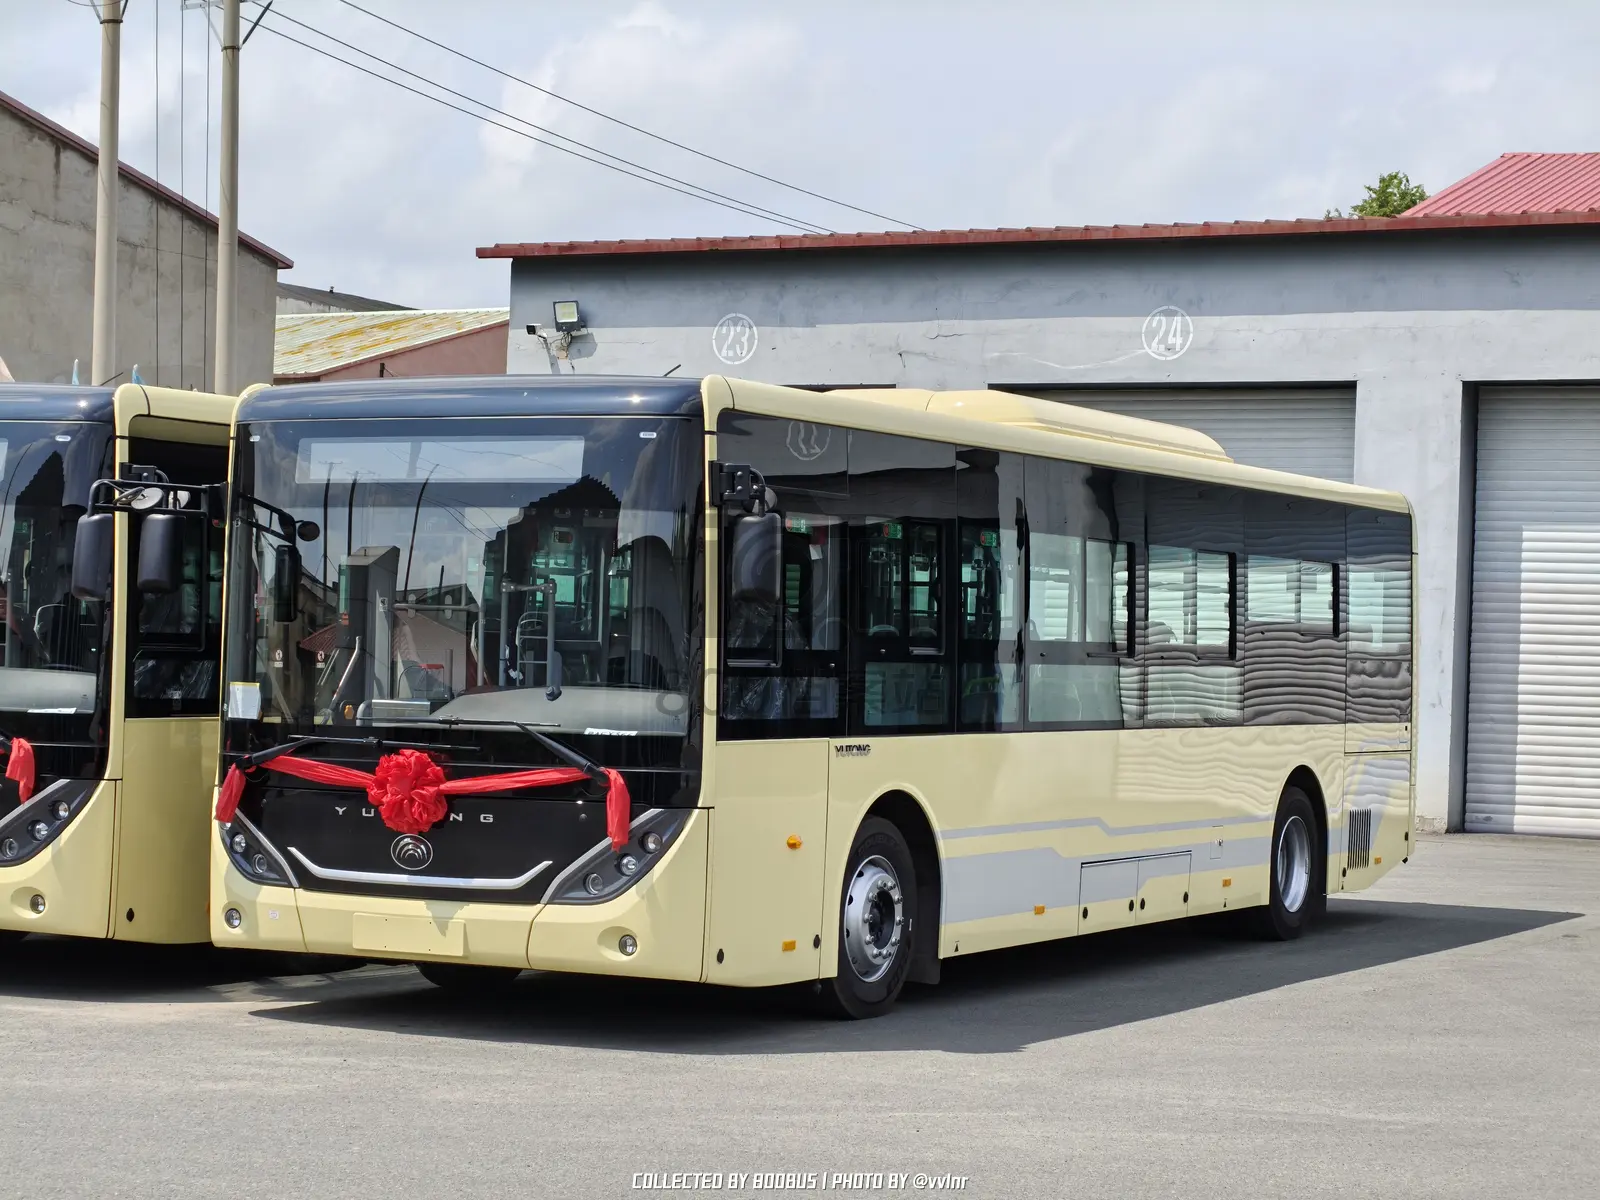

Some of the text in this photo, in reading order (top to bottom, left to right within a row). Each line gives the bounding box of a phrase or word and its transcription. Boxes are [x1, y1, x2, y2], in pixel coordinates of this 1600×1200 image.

[721, 319, 750, 357] 23
[1151, 312, 1183, 352] 24
[834, 744, 871, 757] YUTONG
[335, 806, 494, 823] YUNG
